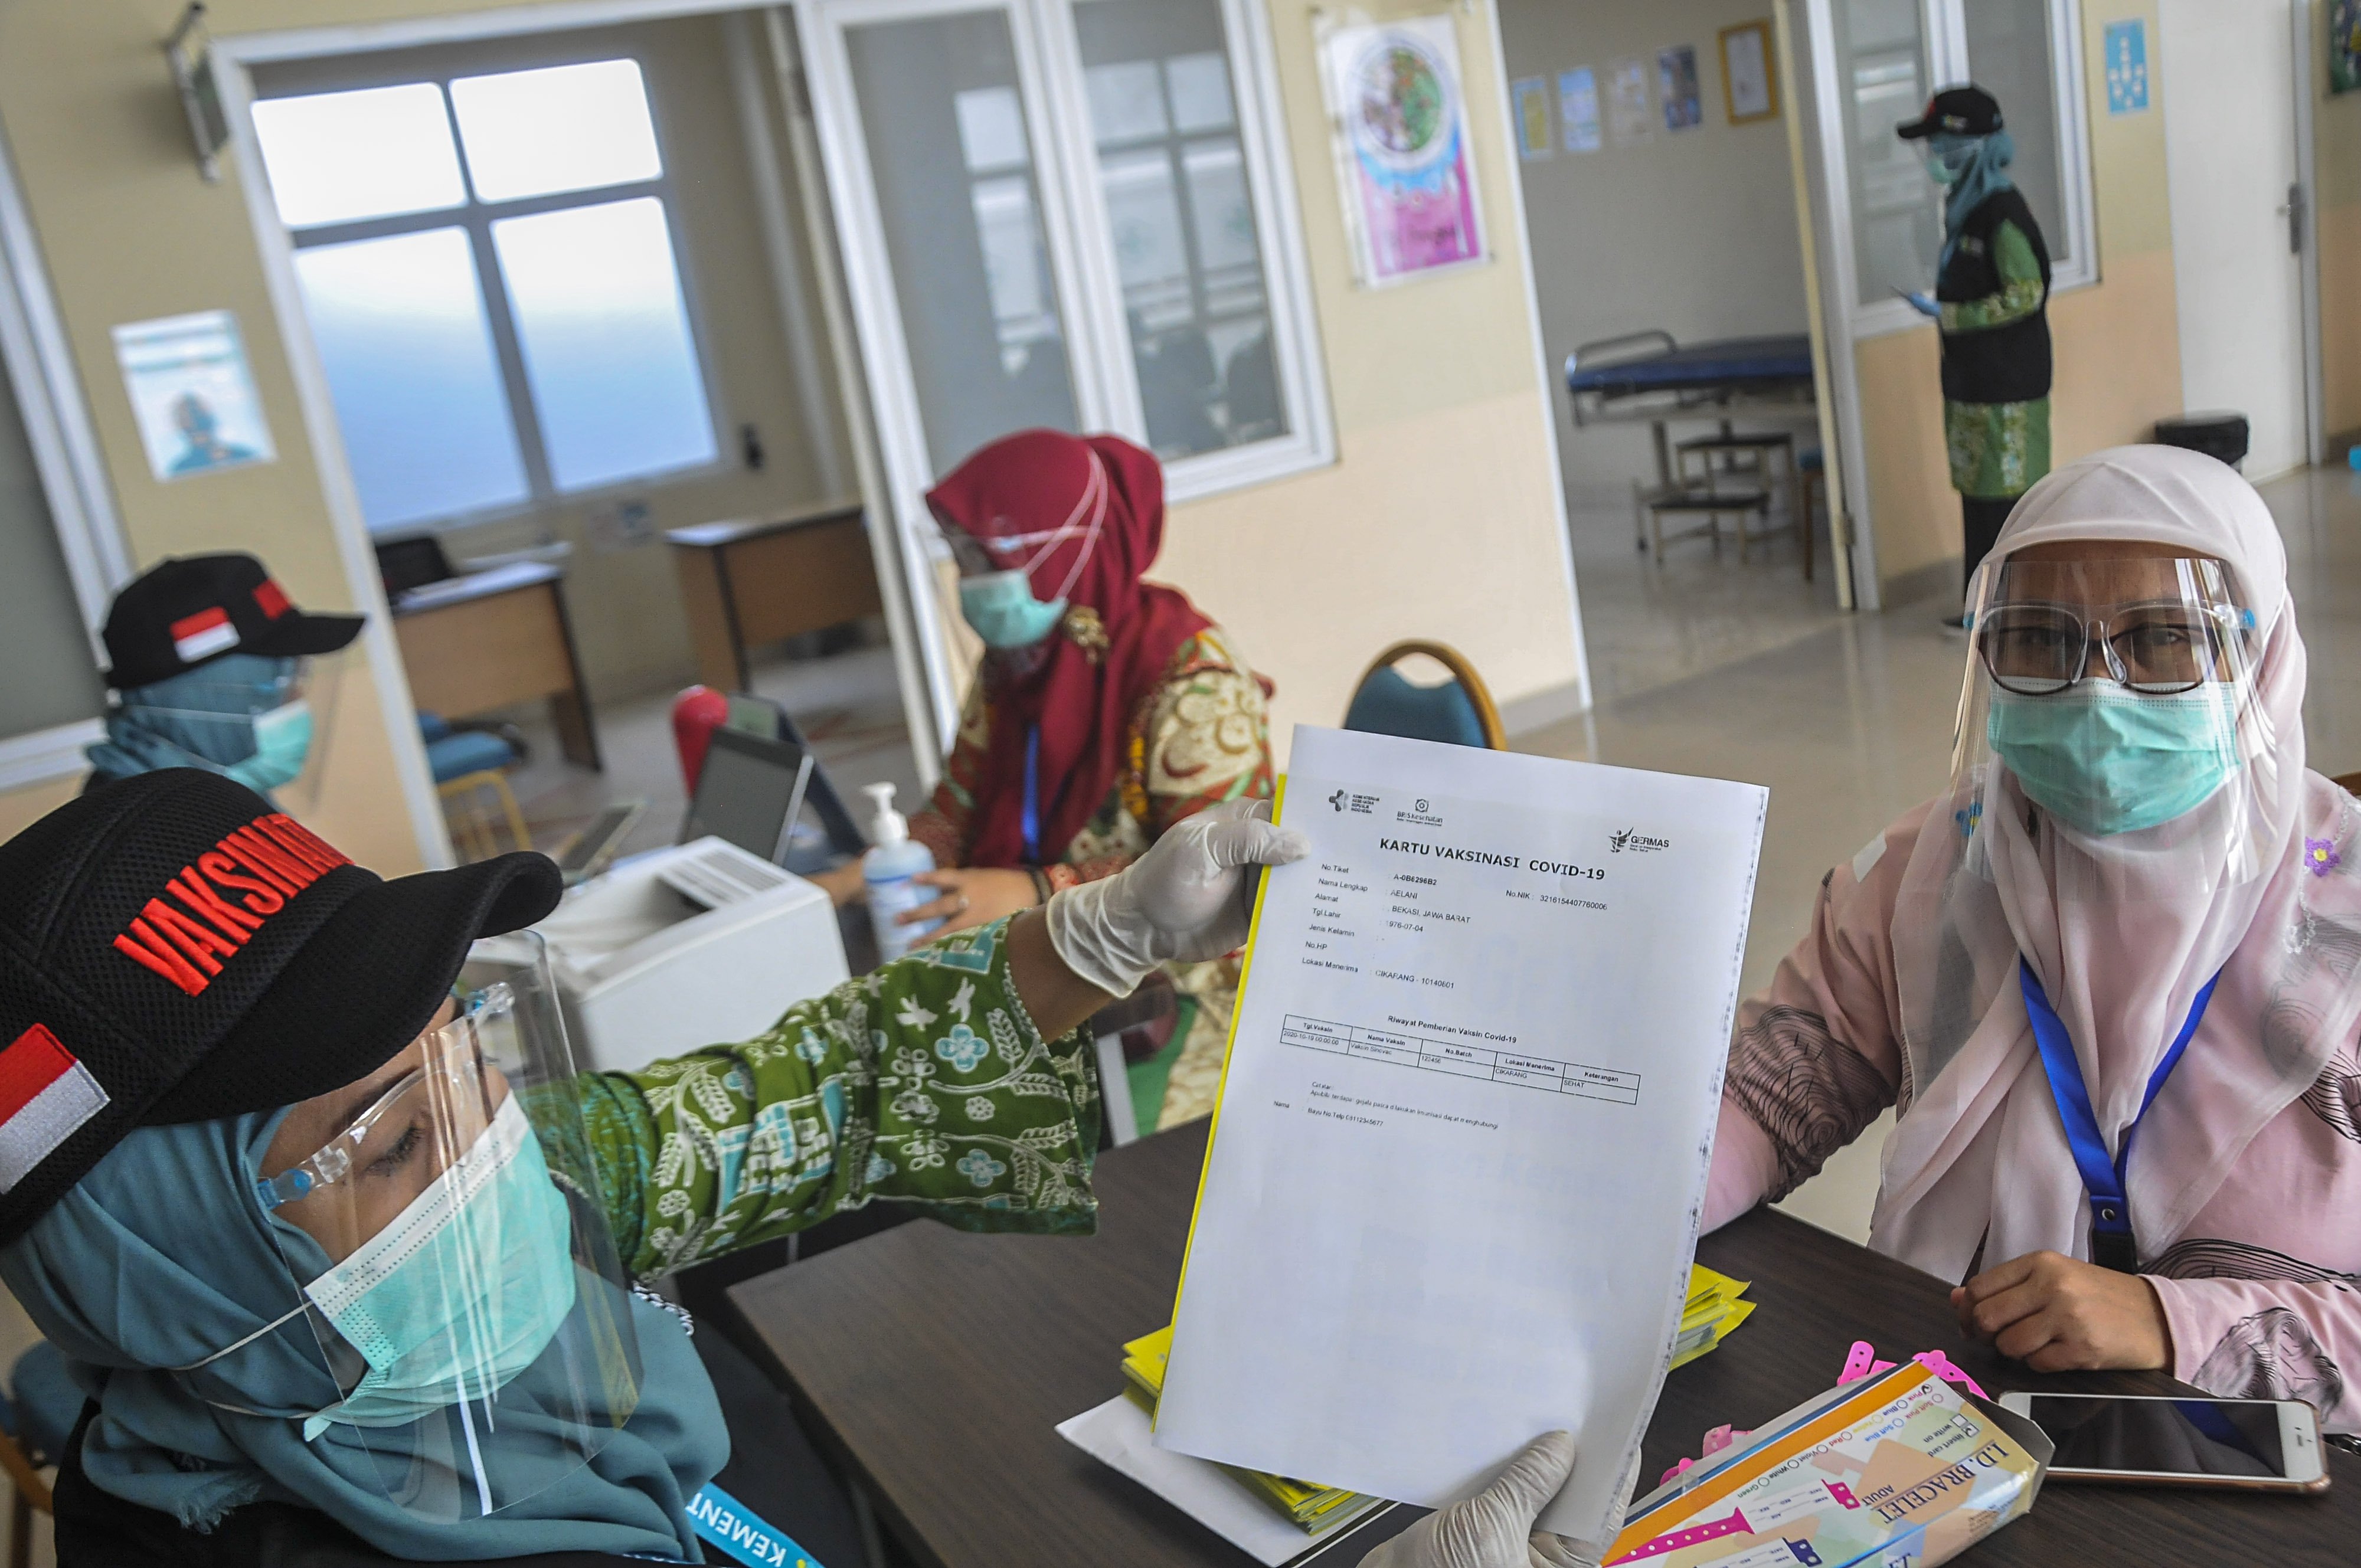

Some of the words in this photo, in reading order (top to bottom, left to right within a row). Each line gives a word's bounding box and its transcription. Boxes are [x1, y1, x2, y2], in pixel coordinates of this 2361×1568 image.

[1631, 836, 1670, 847] GERMAS
[1379, 837, 1430, 855] KARTU
[1435, 845, 1520, 868] VAKSINASI
[1529, 859, 1605, 880] COVID-19
[1318, 878, 1338, 887] Nama
[1339, 880, 1368, 892] Lengkap
[1394, 873, 1437, 886] A-0B6296B2
[1314, 893, 1339, 902] Alamat
[1539, 894, 1608, 911] 3216154407760006
[1423, 910, 1444, 919] JAWA
[1446, 914, 1471, 924] BARAT
[1309, 923, 1326, 932] Jenis
[1327, 927, 1355, 937] Kelamin
[1302, 957, 1324, 967] Lokasi
[1325, 961, 1359, 973] Menerima
[1375, 970, 1415, 983] CIKARANG
[1388, 1015, 1417, 1027] Riwayat
[1418, 1020, 1457, 1035] Pemberian
[1459, 1027, 1483, 1039] Vaksin
[1484, 1030, 1517, 1044] Covid-19
[1367, 1033, 1384, 1043] Nama
[1385, 1037, 1406, 1046] Vaksin
[1445, 1047, 1473, 1058] No.Batch
[1505, 1058, 1525, 1068] Lokasi
[1526, 1062, 1555, 1072] Menerima
[1495, 1068, 1528, 1079] CIKARANG
[1584, 1071, 1620, 1083] Keterangan
[1564, 1079, 1585, 1089] SEHAT
[1273, 1100, 1290, 1109] Nama
[1307, 1107, 1322, 1116] Bayu
[1907, 1391, 1924, 1402] Pink
[1883, 1406, 1899, 1416] Blue
[1905, 1409, 1921, 1419] Pink
[1879, 1423, 1895, 1436] Soft
[1934, 1423, 1953, 1438] write
[1829, 1436, 1844, 1447] Red
[1865, 1433, 1882, 1442] Blue
[1923, 1435, 1934, 1443] on
[1944, 1433, 1965, 1449] insert
[1798, 1450, 1819, 1462] Violet
[1927, 1445, 1944, 1458] card
[1968, 1441, 2009, 1468] I.D.
[1769, 1465, 1790, 1478] White
[1738, 1484, 1759, 1498] Green
[1862, 1484, 1894, 1506] ADULT
[1877, 1463, 1977, 1524] BRACELET
[685, 1492, 787, 1567] KEMENT
